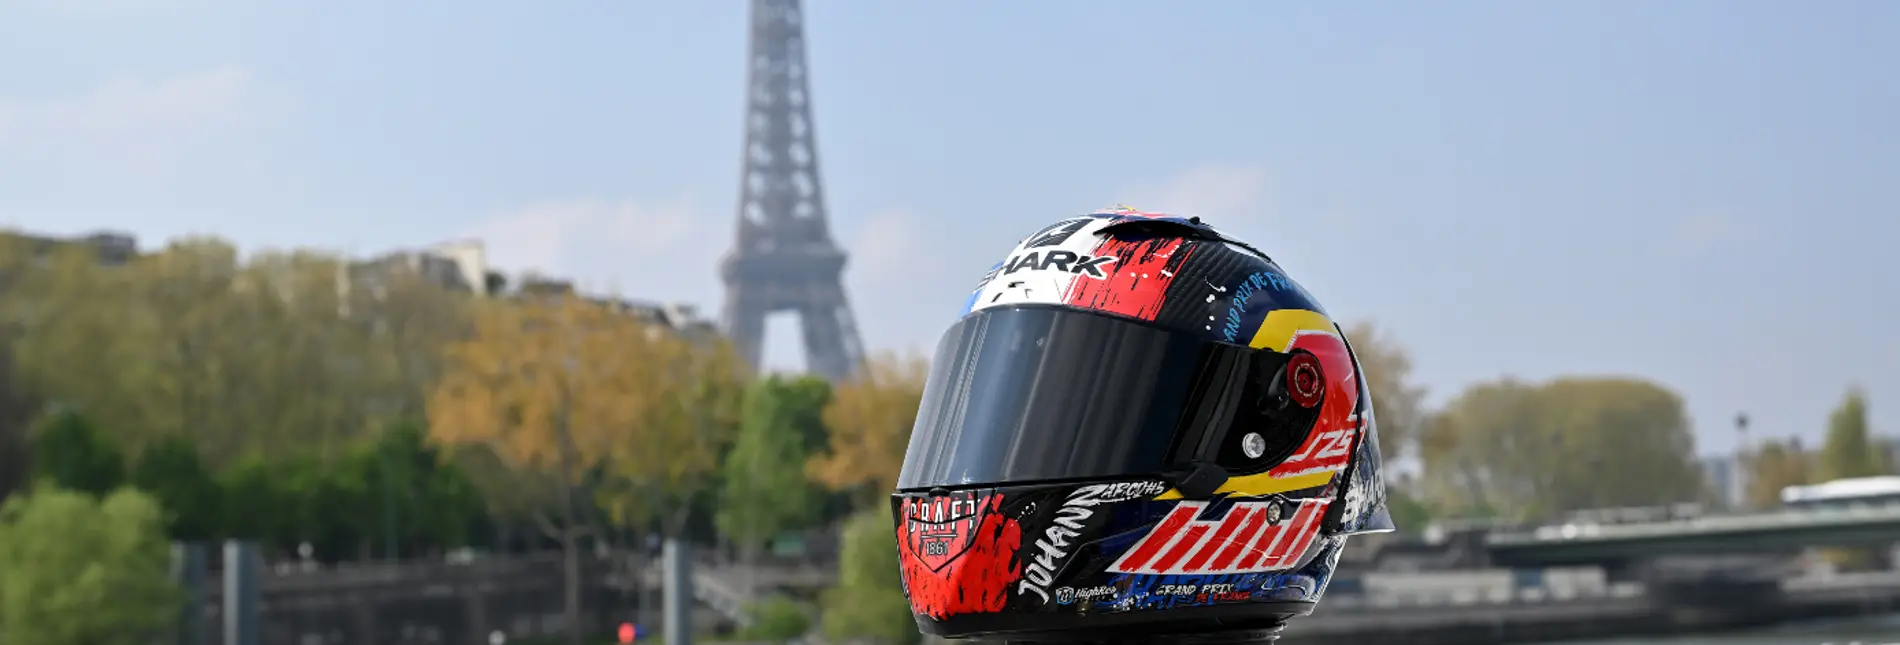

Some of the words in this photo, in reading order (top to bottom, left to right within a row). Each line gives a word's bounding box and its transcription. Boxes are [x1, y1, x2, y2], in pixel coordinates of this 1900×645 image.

[925, 541, 949, 555] 1861
[1155, 584, 1197, 596] GRAND
[1202, 583, 1235, 594] PRIX
